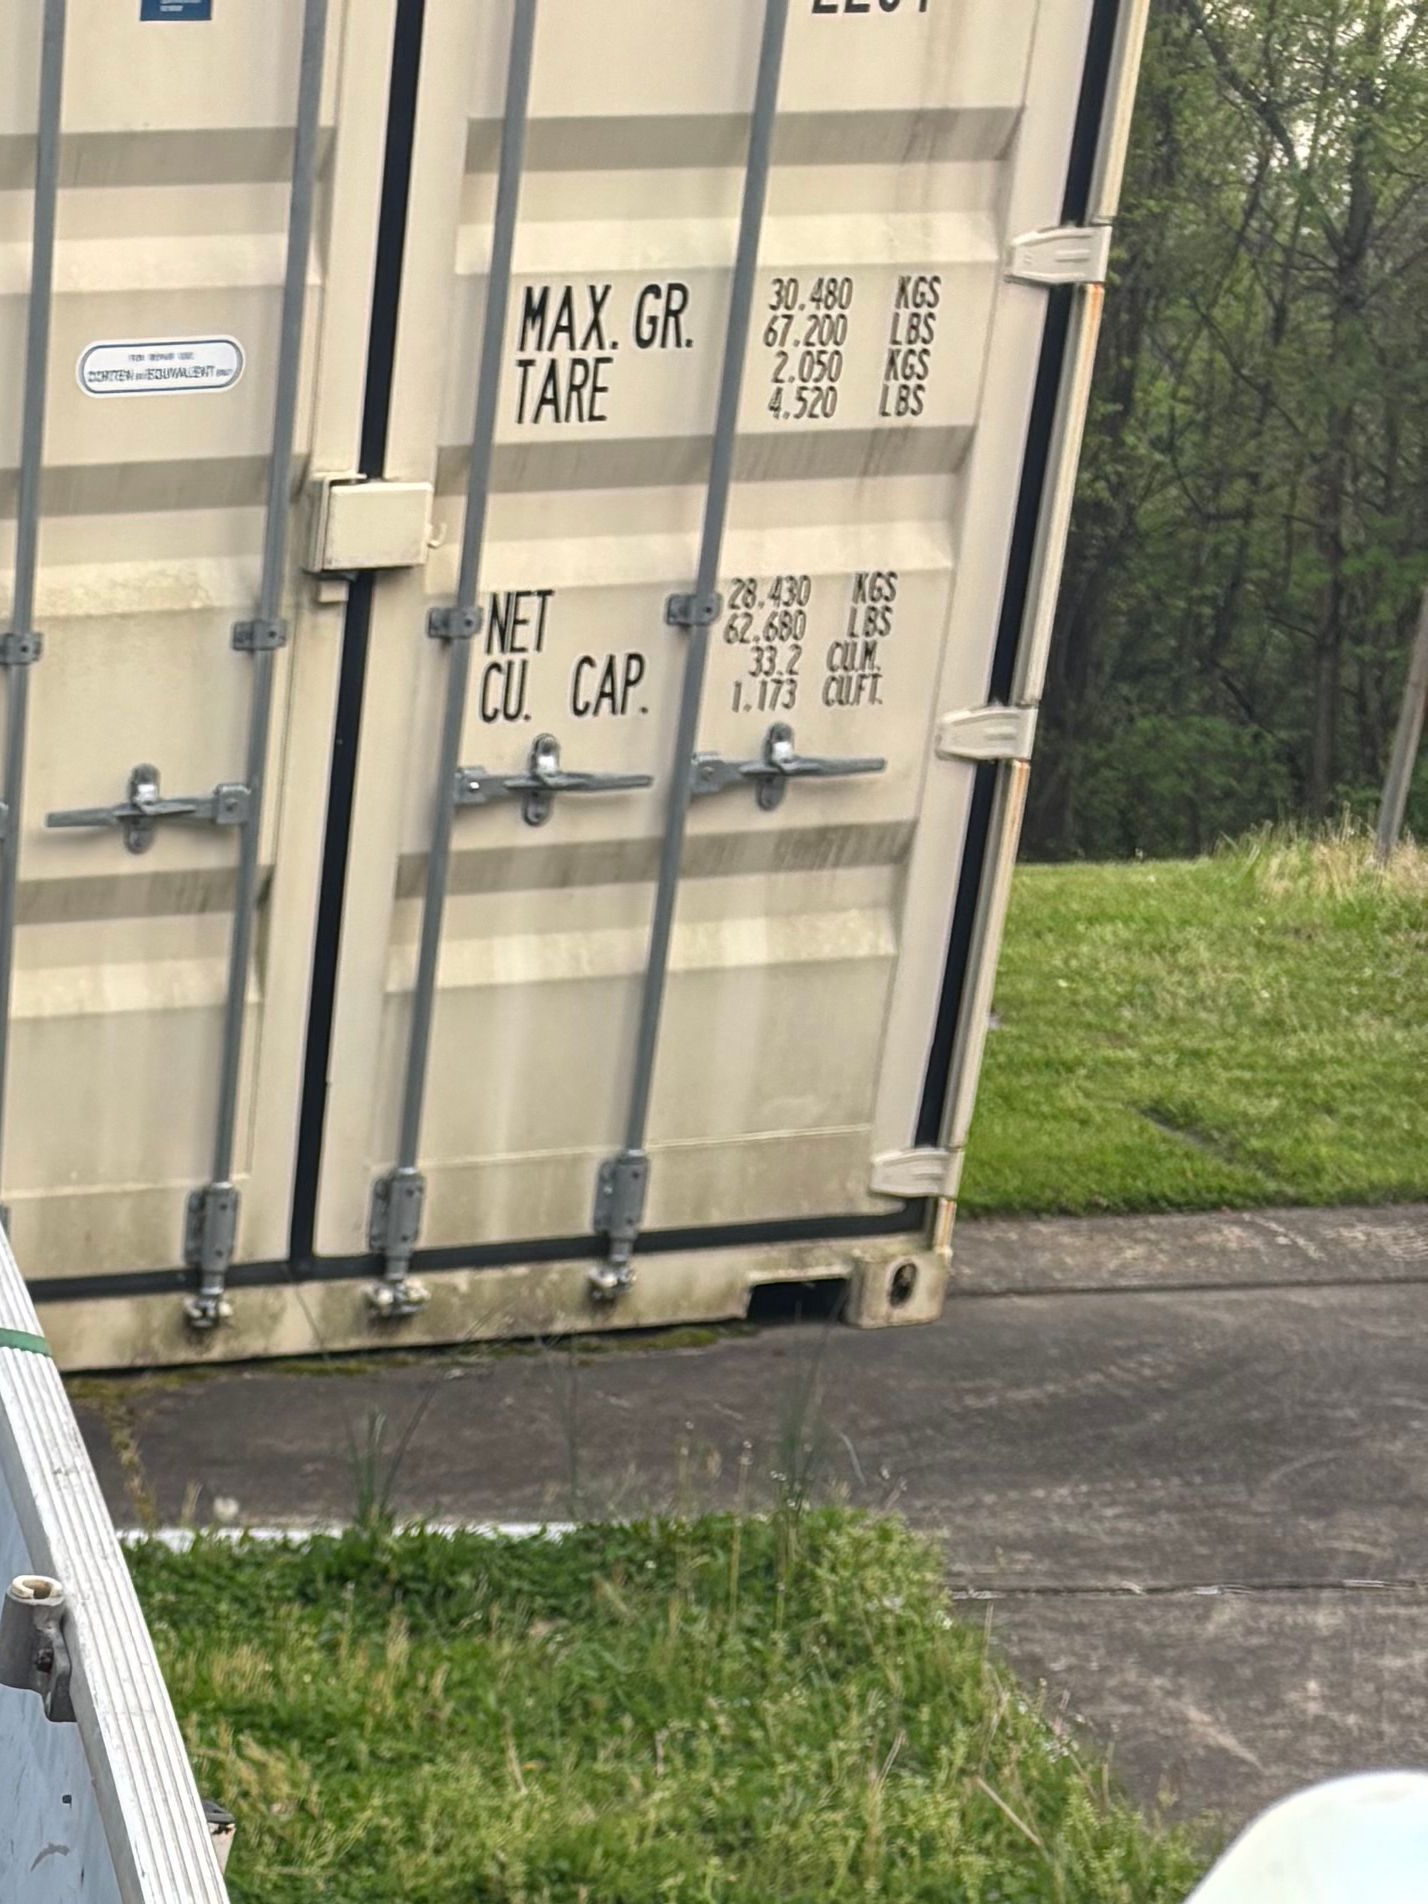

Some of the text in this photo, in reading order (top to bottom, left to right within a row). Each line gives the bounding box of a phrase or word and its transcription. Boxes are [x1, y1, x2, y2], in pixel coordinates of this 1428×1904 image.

[768, 275, 943, 312] 30.480 KGS
[517, 282, 694, 352] MAX. GR.
[763, 311, 937, 348] 67.200 LBS
[770, 348, 931, 384] 2.050 KGS
[515, 357, 614, 424] TARE
[767, 384, 927, 420] 4.520 LBS
[727, 571, 898, 611] 28.430 KGS
[486, 590, 555, 655] NET
[723, 605, 893, 644] 62.680 LBS
[748, 643, 802, 677] 33.2
[481, 653, 648, 723] CU. CAP.
[731, 679, 798, 713] 1.173
